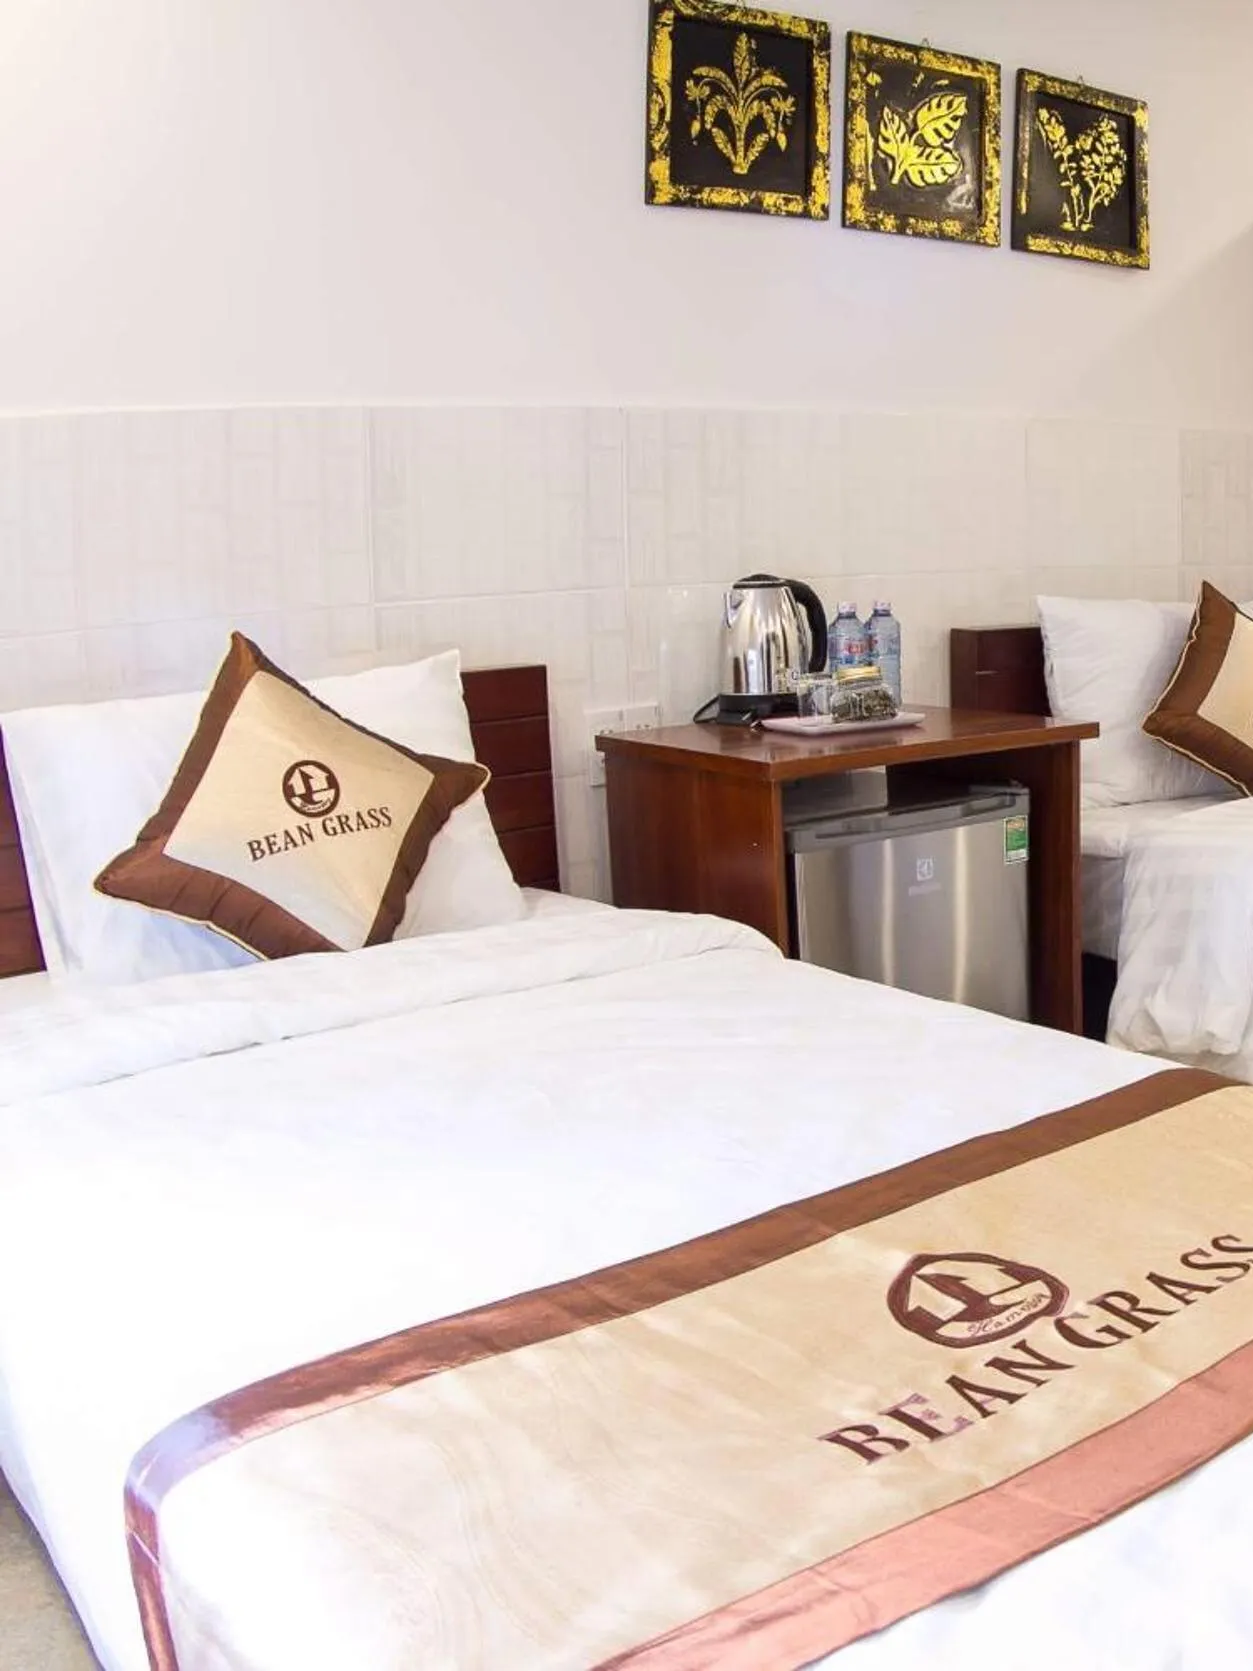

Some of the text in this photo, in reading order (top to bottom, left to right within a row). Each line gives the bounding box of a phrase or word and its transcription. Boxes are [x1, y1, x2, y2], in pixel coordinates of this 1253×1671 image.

[247, 806, 393, 862] BEAN GRASS
[818, 1339, 1076, 1465] BEAN
